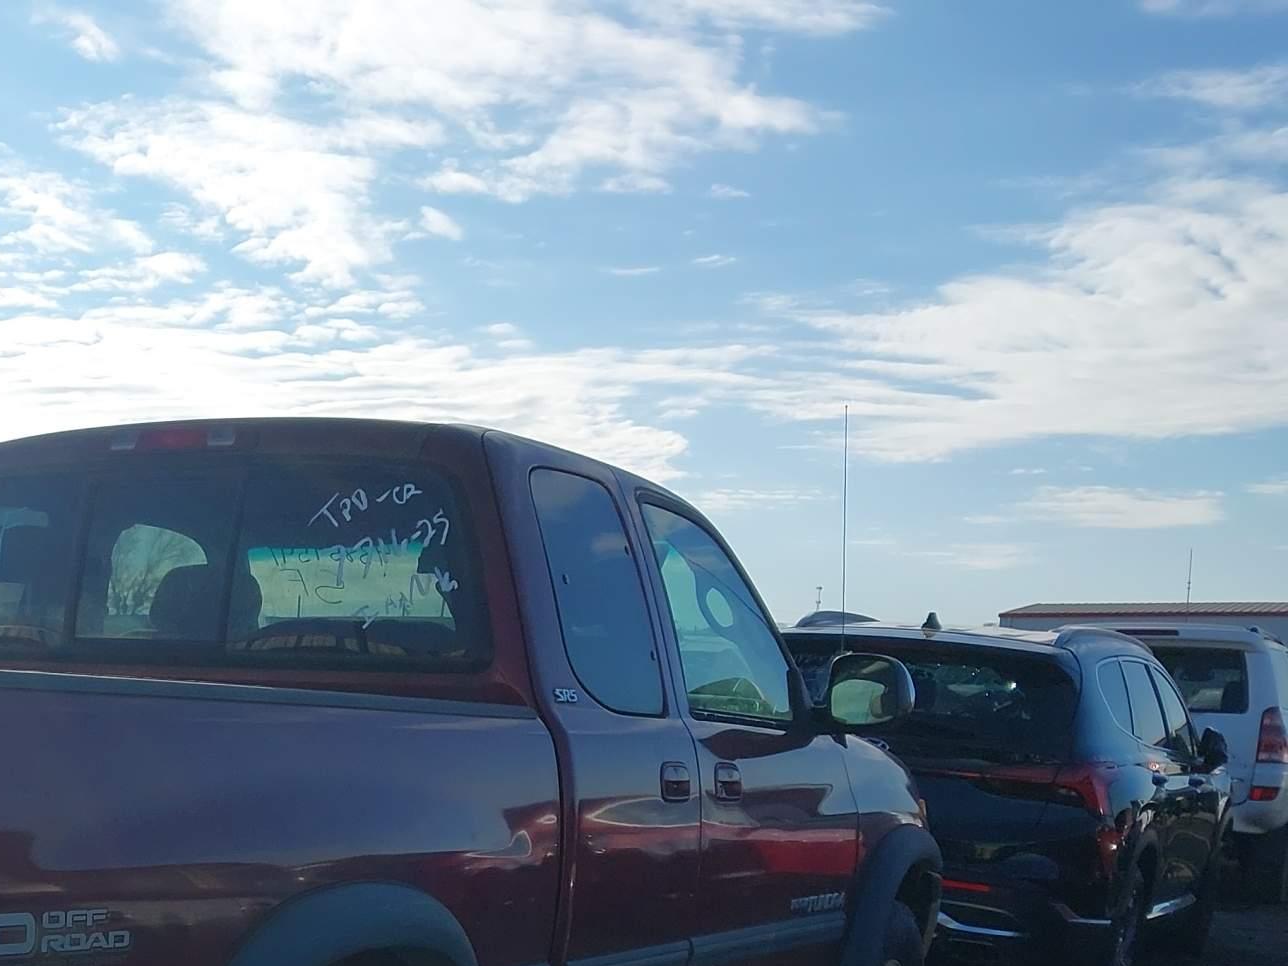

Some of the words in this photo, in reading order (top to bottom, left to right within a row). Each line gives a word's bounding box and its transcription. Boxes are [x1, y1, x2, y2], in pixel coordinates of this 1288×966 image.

[553, 688, 578, 702] SR5
[42, 908, 108, 929] OFF
[41, 930, 131, 953] ROAD
